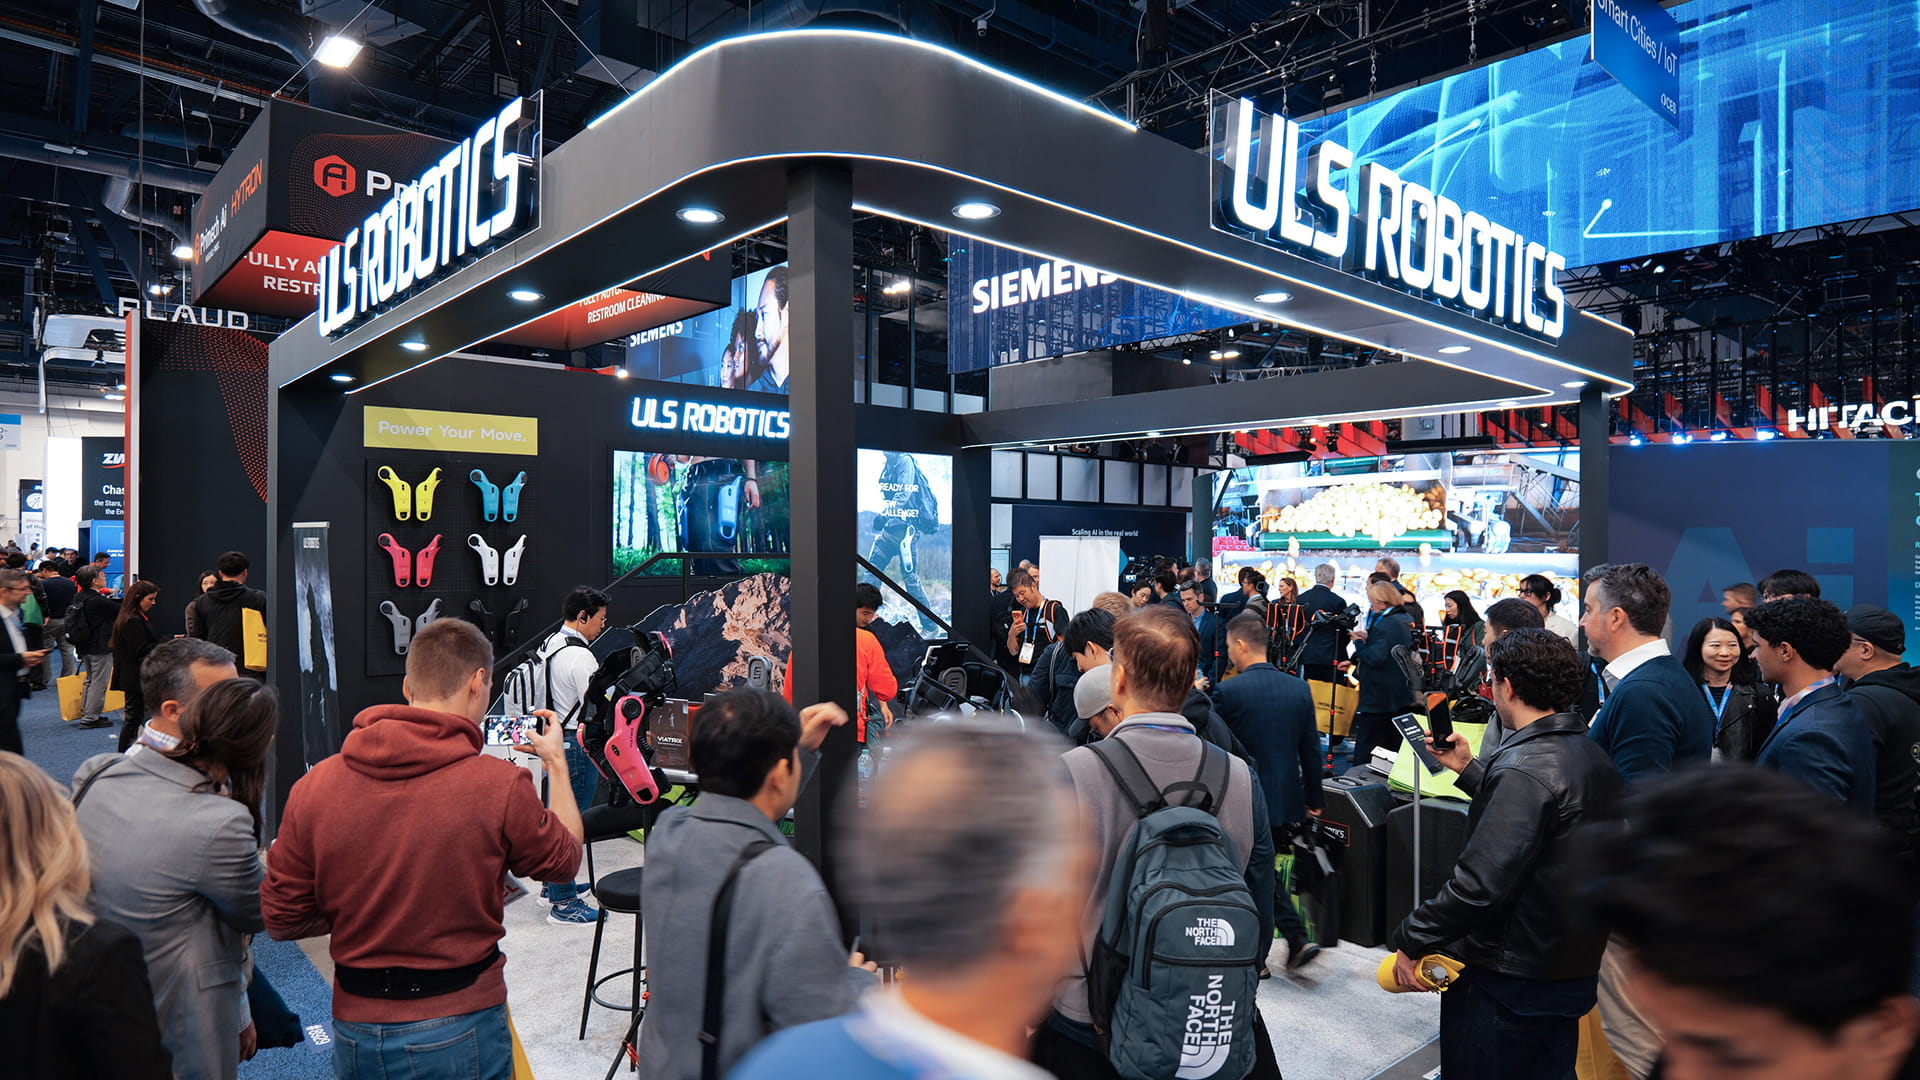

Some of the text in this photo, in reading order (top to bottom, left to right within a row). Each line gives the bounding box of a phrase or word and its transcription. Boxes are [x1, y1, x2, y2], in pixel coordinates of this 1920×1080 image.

[1630, 15, 1657, 59] Cities
[1664, 46, 1677, 77] IoT
[231, 158, 264, 218] HYTRON
[319, 96, 523, 338] ULS ROBOTICS
[1232, 96, 1566, 338] ULS ROBOTICS
[243, 251, 299, 271] ULLY
[118, 297, 249, 330] PLAUD
[587, 300, 626, 324] RESTROOM
[629, 320, 683, 347] SIEMENS
[631, 397, 791, 438] ULS ROBOTICS
[378, 420, 527, 442] Power Your Move.
[880, 483, 919, 492] READY FOR
[105, 500, 122, 508] Stars,
[1071, 528, 1091, 537] Scaling
[1114, 529, 1124, 537] real
[657, 736, 683, 744] VIATRIX
[1185, 927, 1218, 937] NORTH
[1197, 918, 1217, 928] THE
[1194, 936, 1217, 946] FACE
[1184, 995, 1206, 1045] FACE
[1201, 974, 1224, 1046] NORTH
[1217, 1000, 1236, 1046] THE
